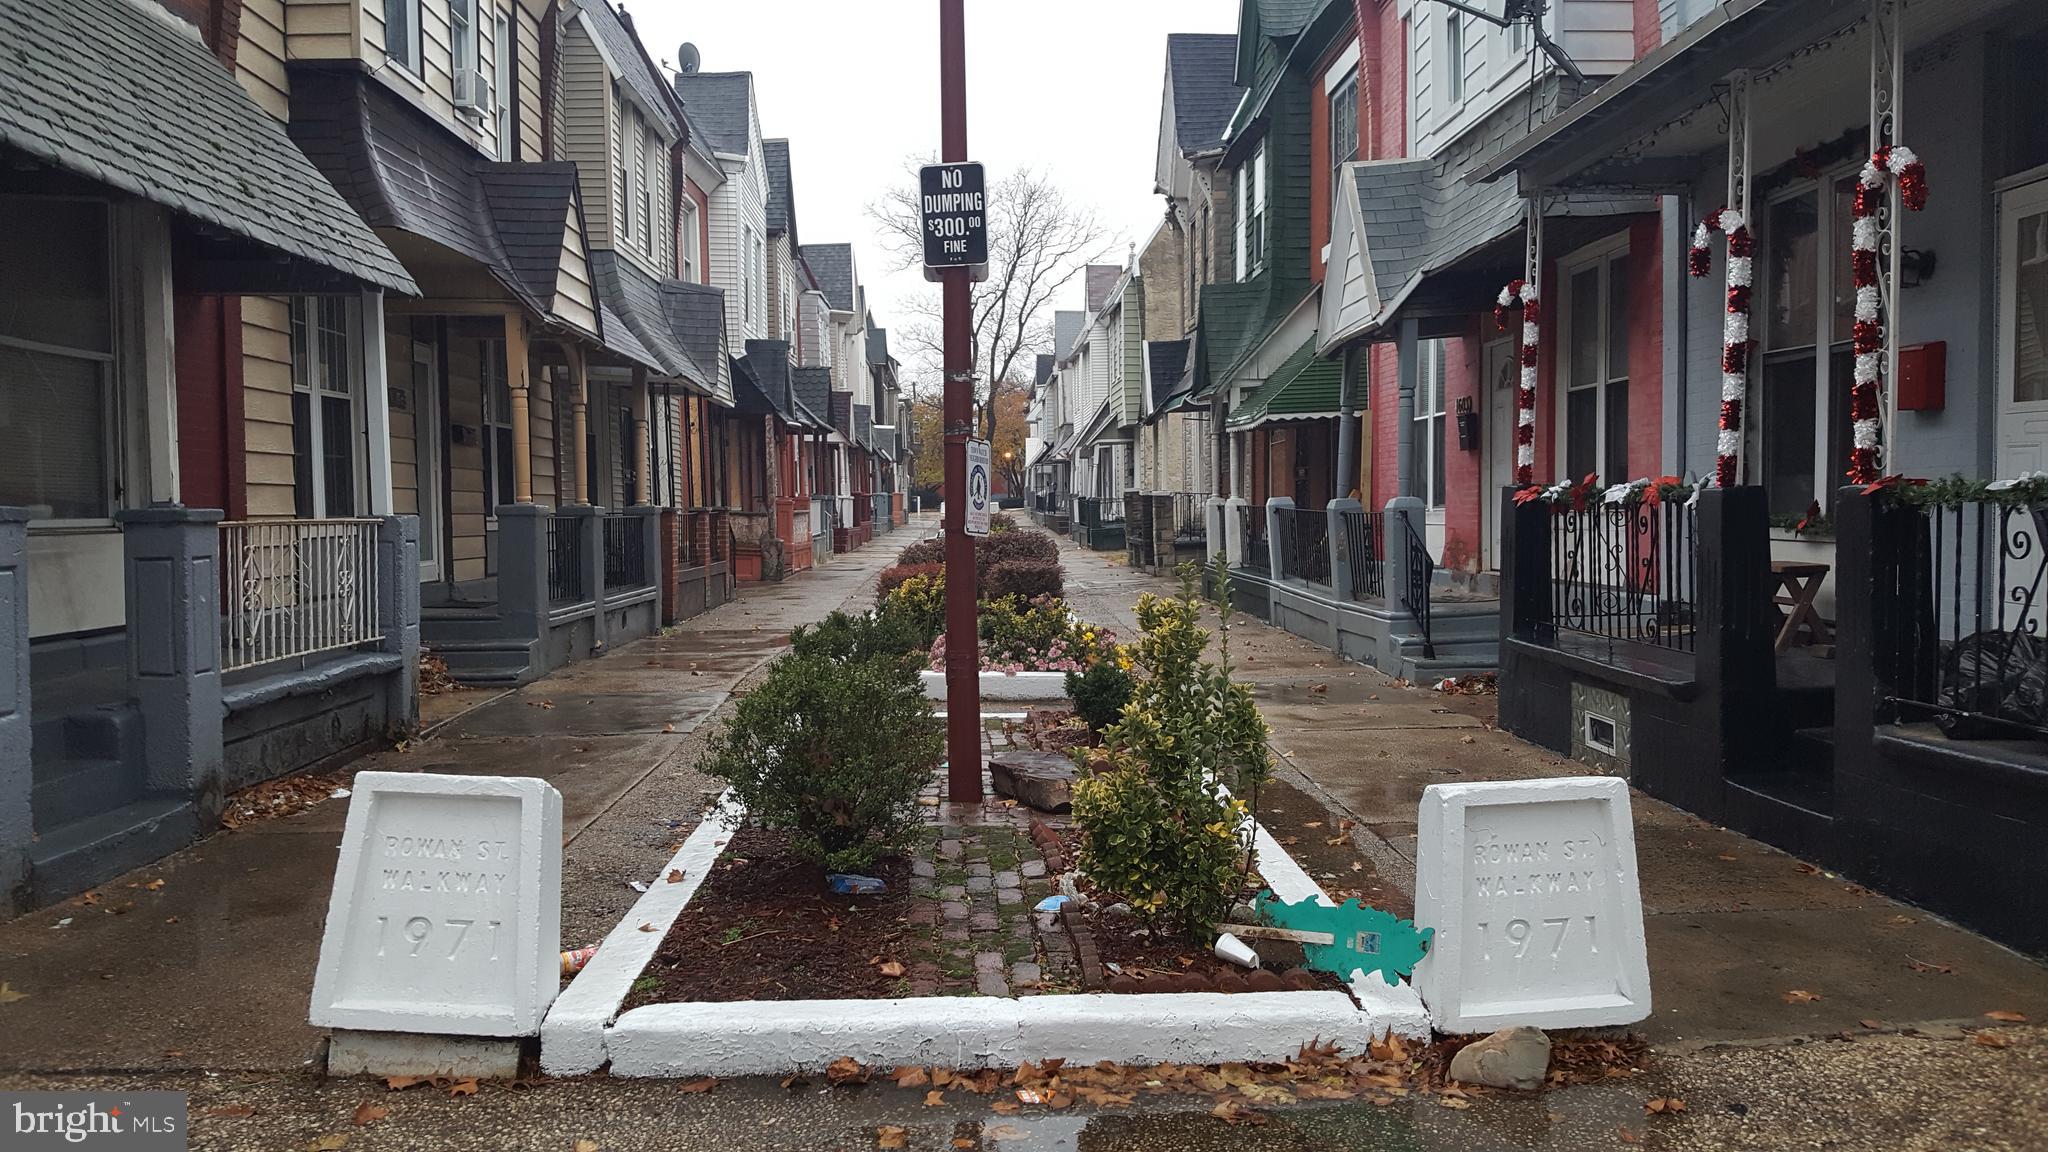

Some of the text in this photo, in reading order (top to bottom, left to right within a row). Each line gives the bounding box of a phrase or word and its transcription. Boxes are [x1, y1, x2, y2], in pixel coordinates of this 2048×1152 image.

[941, 169, 963, 189] NO
[924, 192, 983, 214] DUMPING
[943, 240, 968, 253] FINE
[384, 835, 463, 859] ROWAN
[1473, 841, 1549, 864] ROWAN
[382, 869, 506, 894] WALKWAY
[1475, 870, 1593, 897] WALKWAY
[376, 916, 502, 961] 1971
[1476, 915, 1599, 961] 1971
